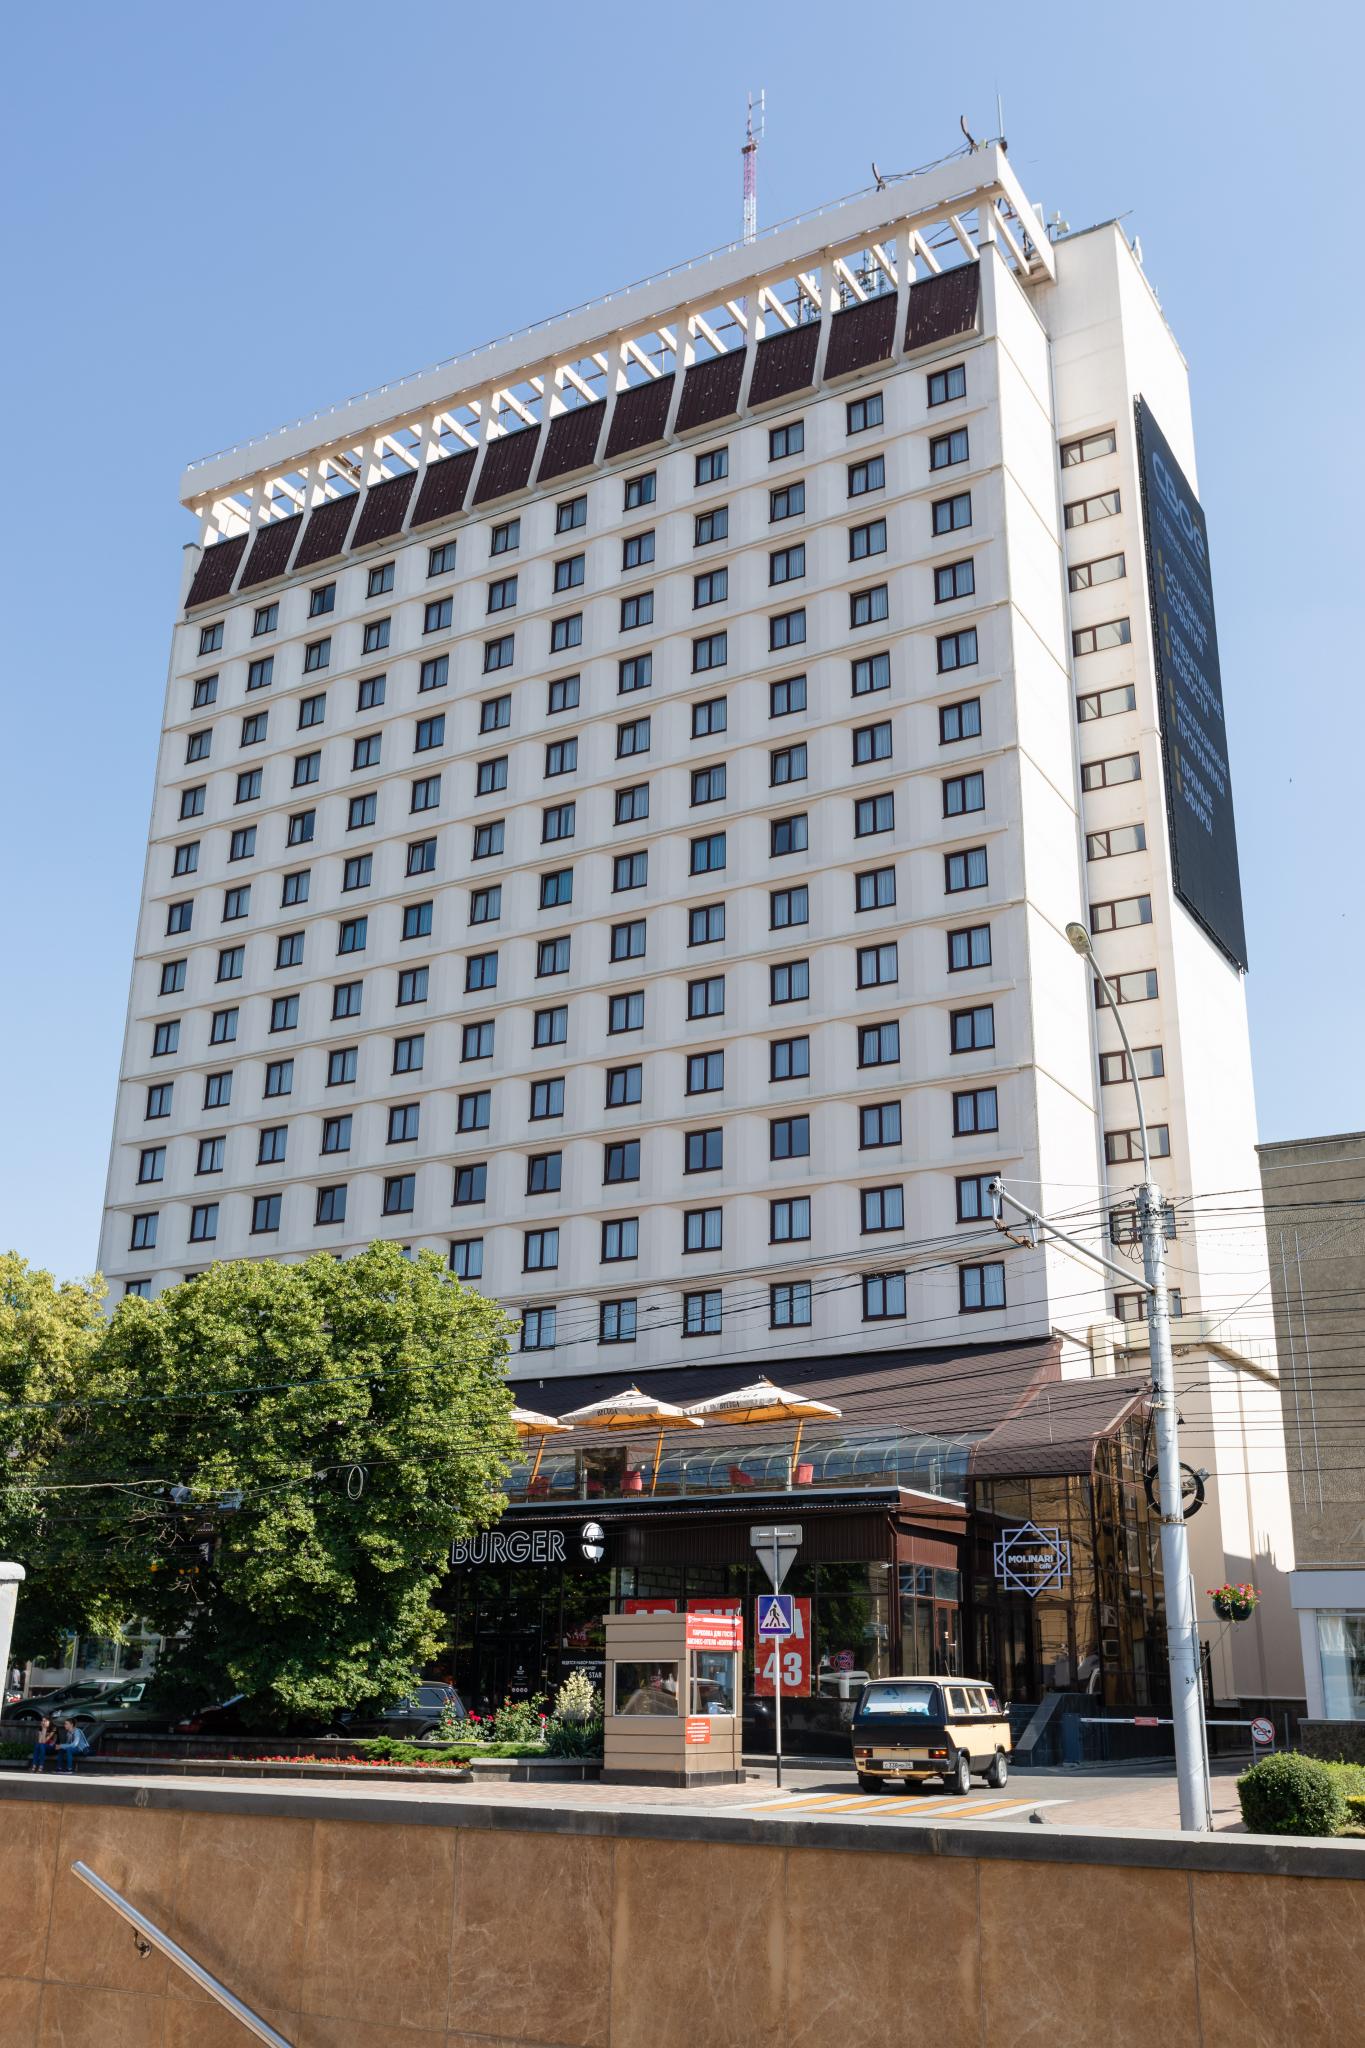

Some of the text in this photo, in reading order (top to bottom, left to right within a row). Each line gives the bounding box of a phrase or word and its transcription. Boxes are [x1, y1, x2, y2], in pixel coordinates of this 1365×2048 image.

[1164, 563, 1207, 645] ОСНОВНЫЕ
[1166, 586, 1204, 656] СОБЫТИЯ
[1170, 626, 1222, 720] ОПЕРАТИВНЫЕ
[1172, 647, 1209, 718] НОВОСТИ
[1176, 690, 1227, 778] ЭКСКЛЮЗИВНЫЕ
[1177, 714, 1225, 798] ПРОГРАММЫ
[1181, 755, 1214, 815] ПРЯМЫЕ
[1183, 782, 1212, 837] ЭФИРЫ
[451, 1530, 567, 1564] BURGER
[1008, 1554, 1053, 1564] MOLINARI
